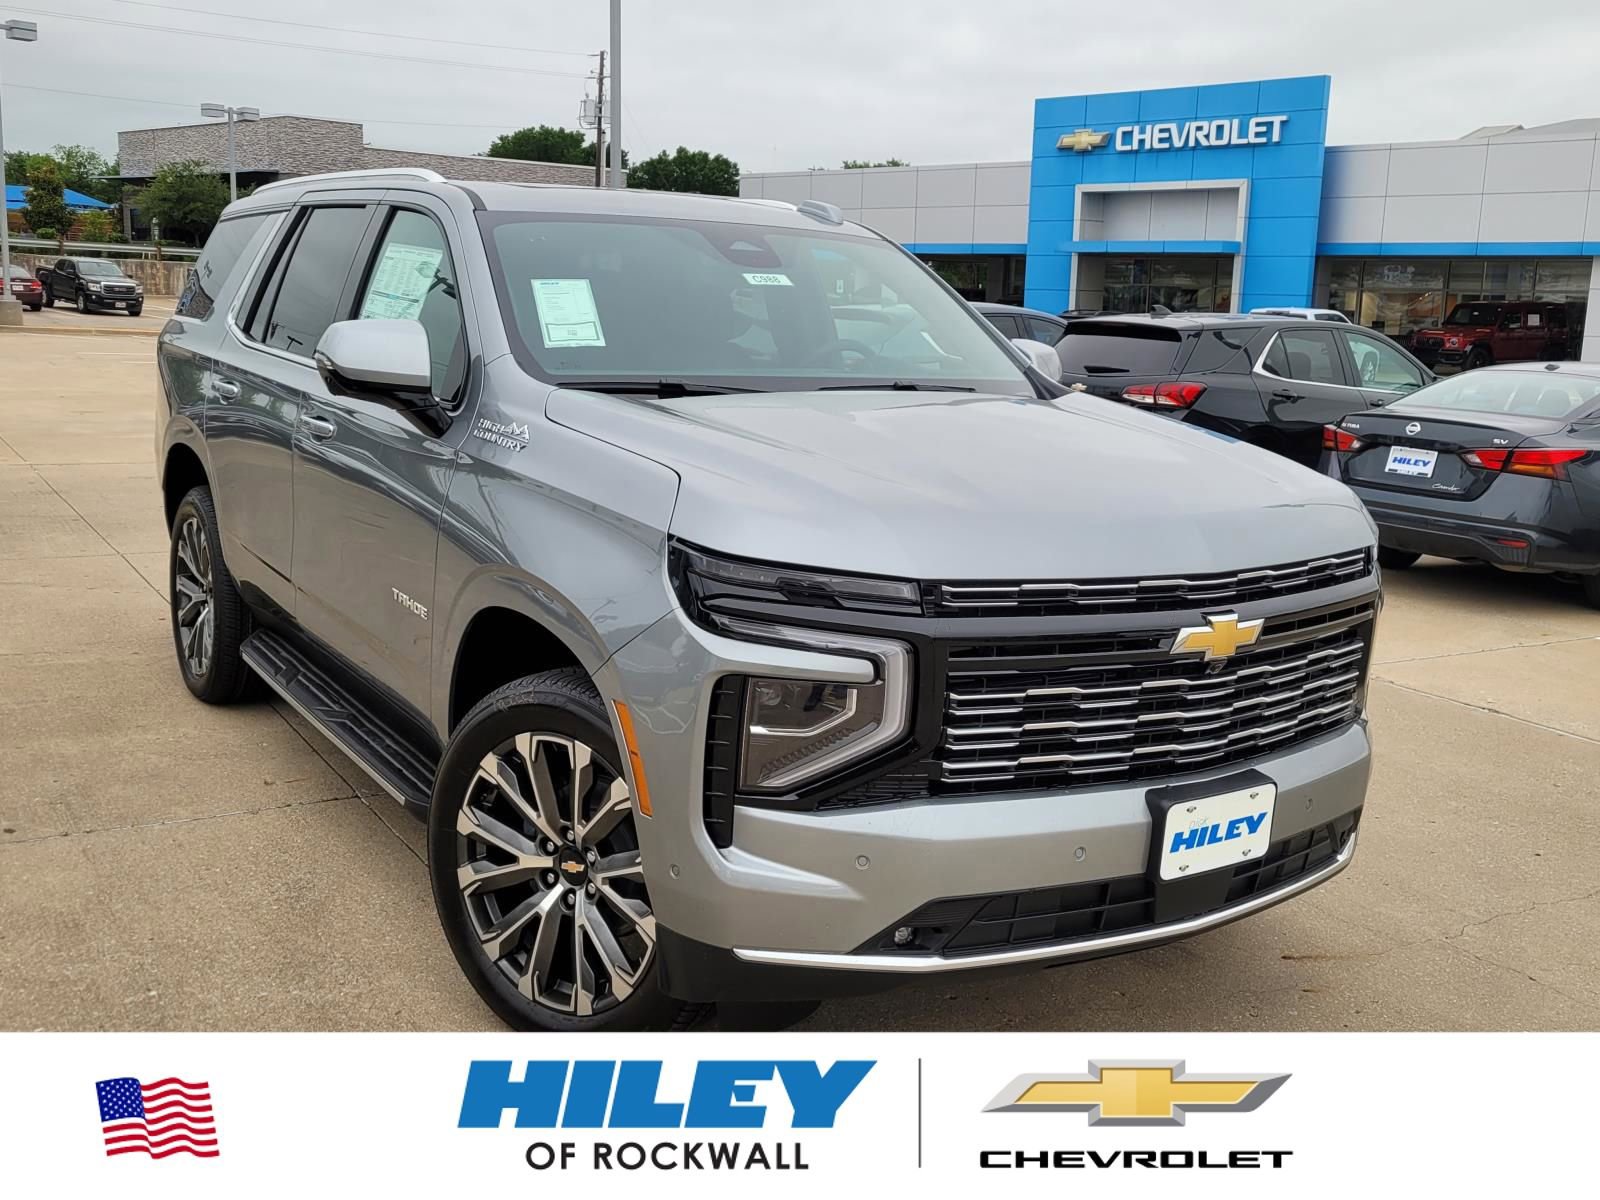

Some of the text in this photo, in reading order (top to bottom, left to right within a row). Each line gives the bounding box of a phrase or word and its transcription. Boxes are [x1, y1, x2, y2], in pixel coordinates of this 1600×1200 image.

[1115, 115, 1288, 152] CHEVROLET
[478, 418, 505, 433] HIGH
[473, 429, 528, 452] COUNTRY
[1392, 456, 1431, 467] HILEY
[391, 587, 428, 620] TAHOE
[1169, 811, 1268, 854] HILEY
